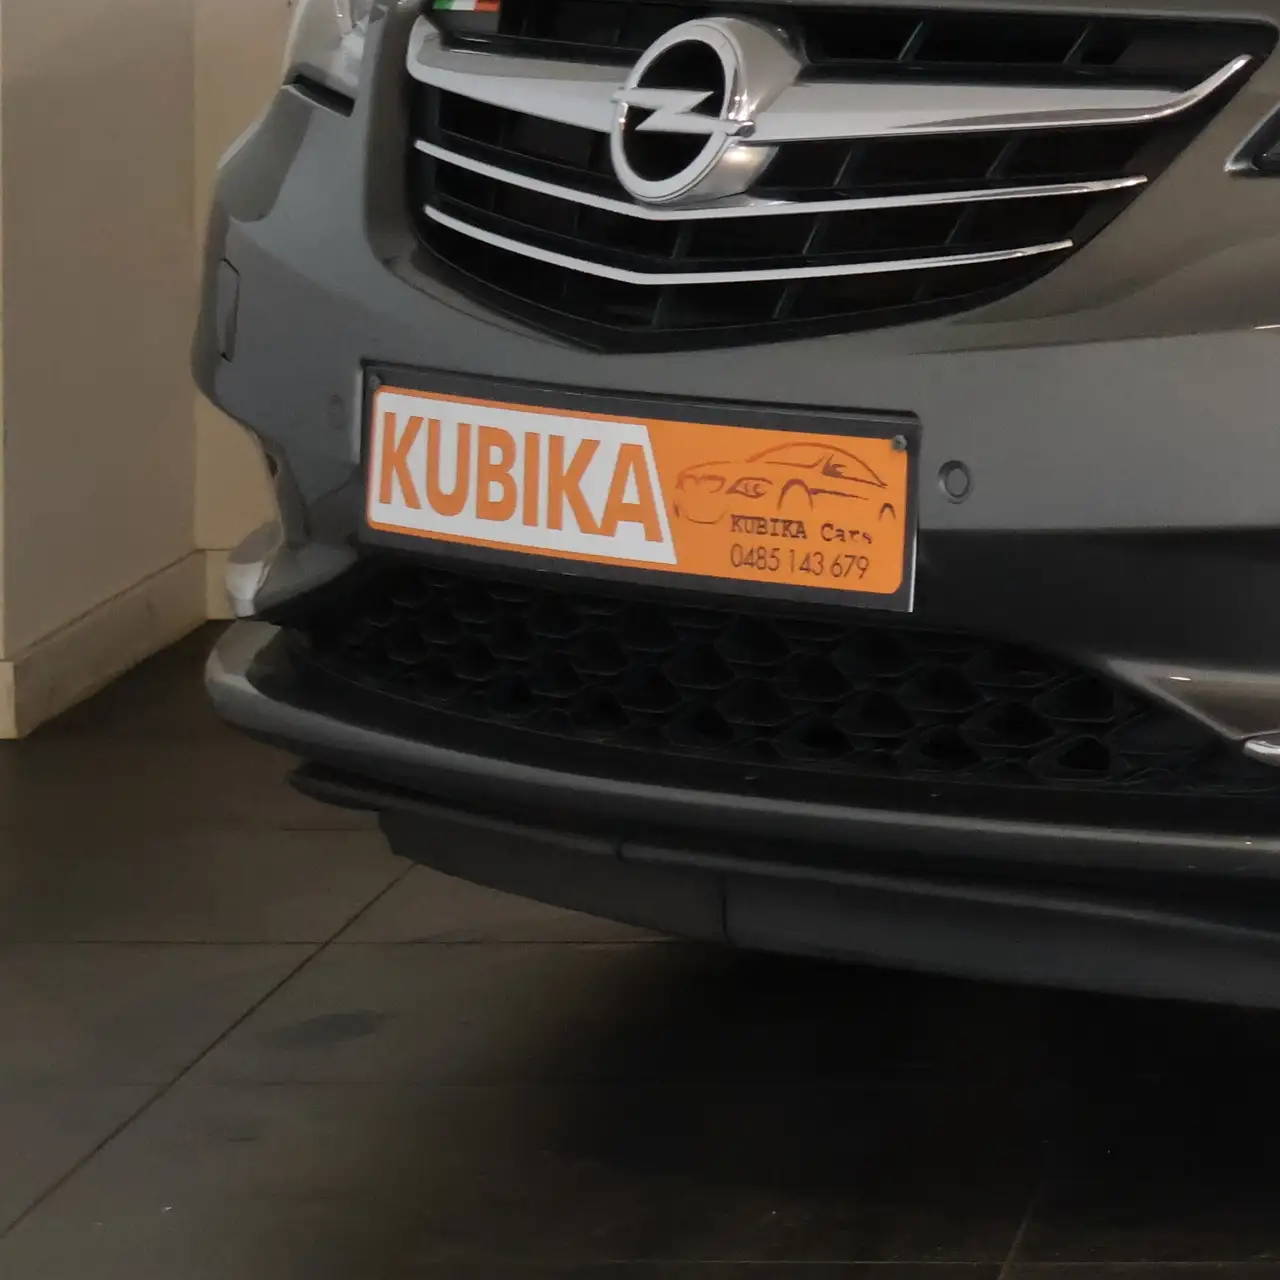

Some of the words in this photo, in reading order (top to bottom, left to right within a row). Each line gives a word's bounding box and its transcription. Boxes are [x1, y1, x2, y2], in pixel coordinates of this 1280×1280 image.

[379, 411, 664, 543] KUBIKA
[730, 514, 808, 540] KUBIKA
[820, 522, 873, 545] Cars
[730, 543, 781, 572] 0485
[788, 549, 825, 577] 143
[829, 553, 870, 581] 679
